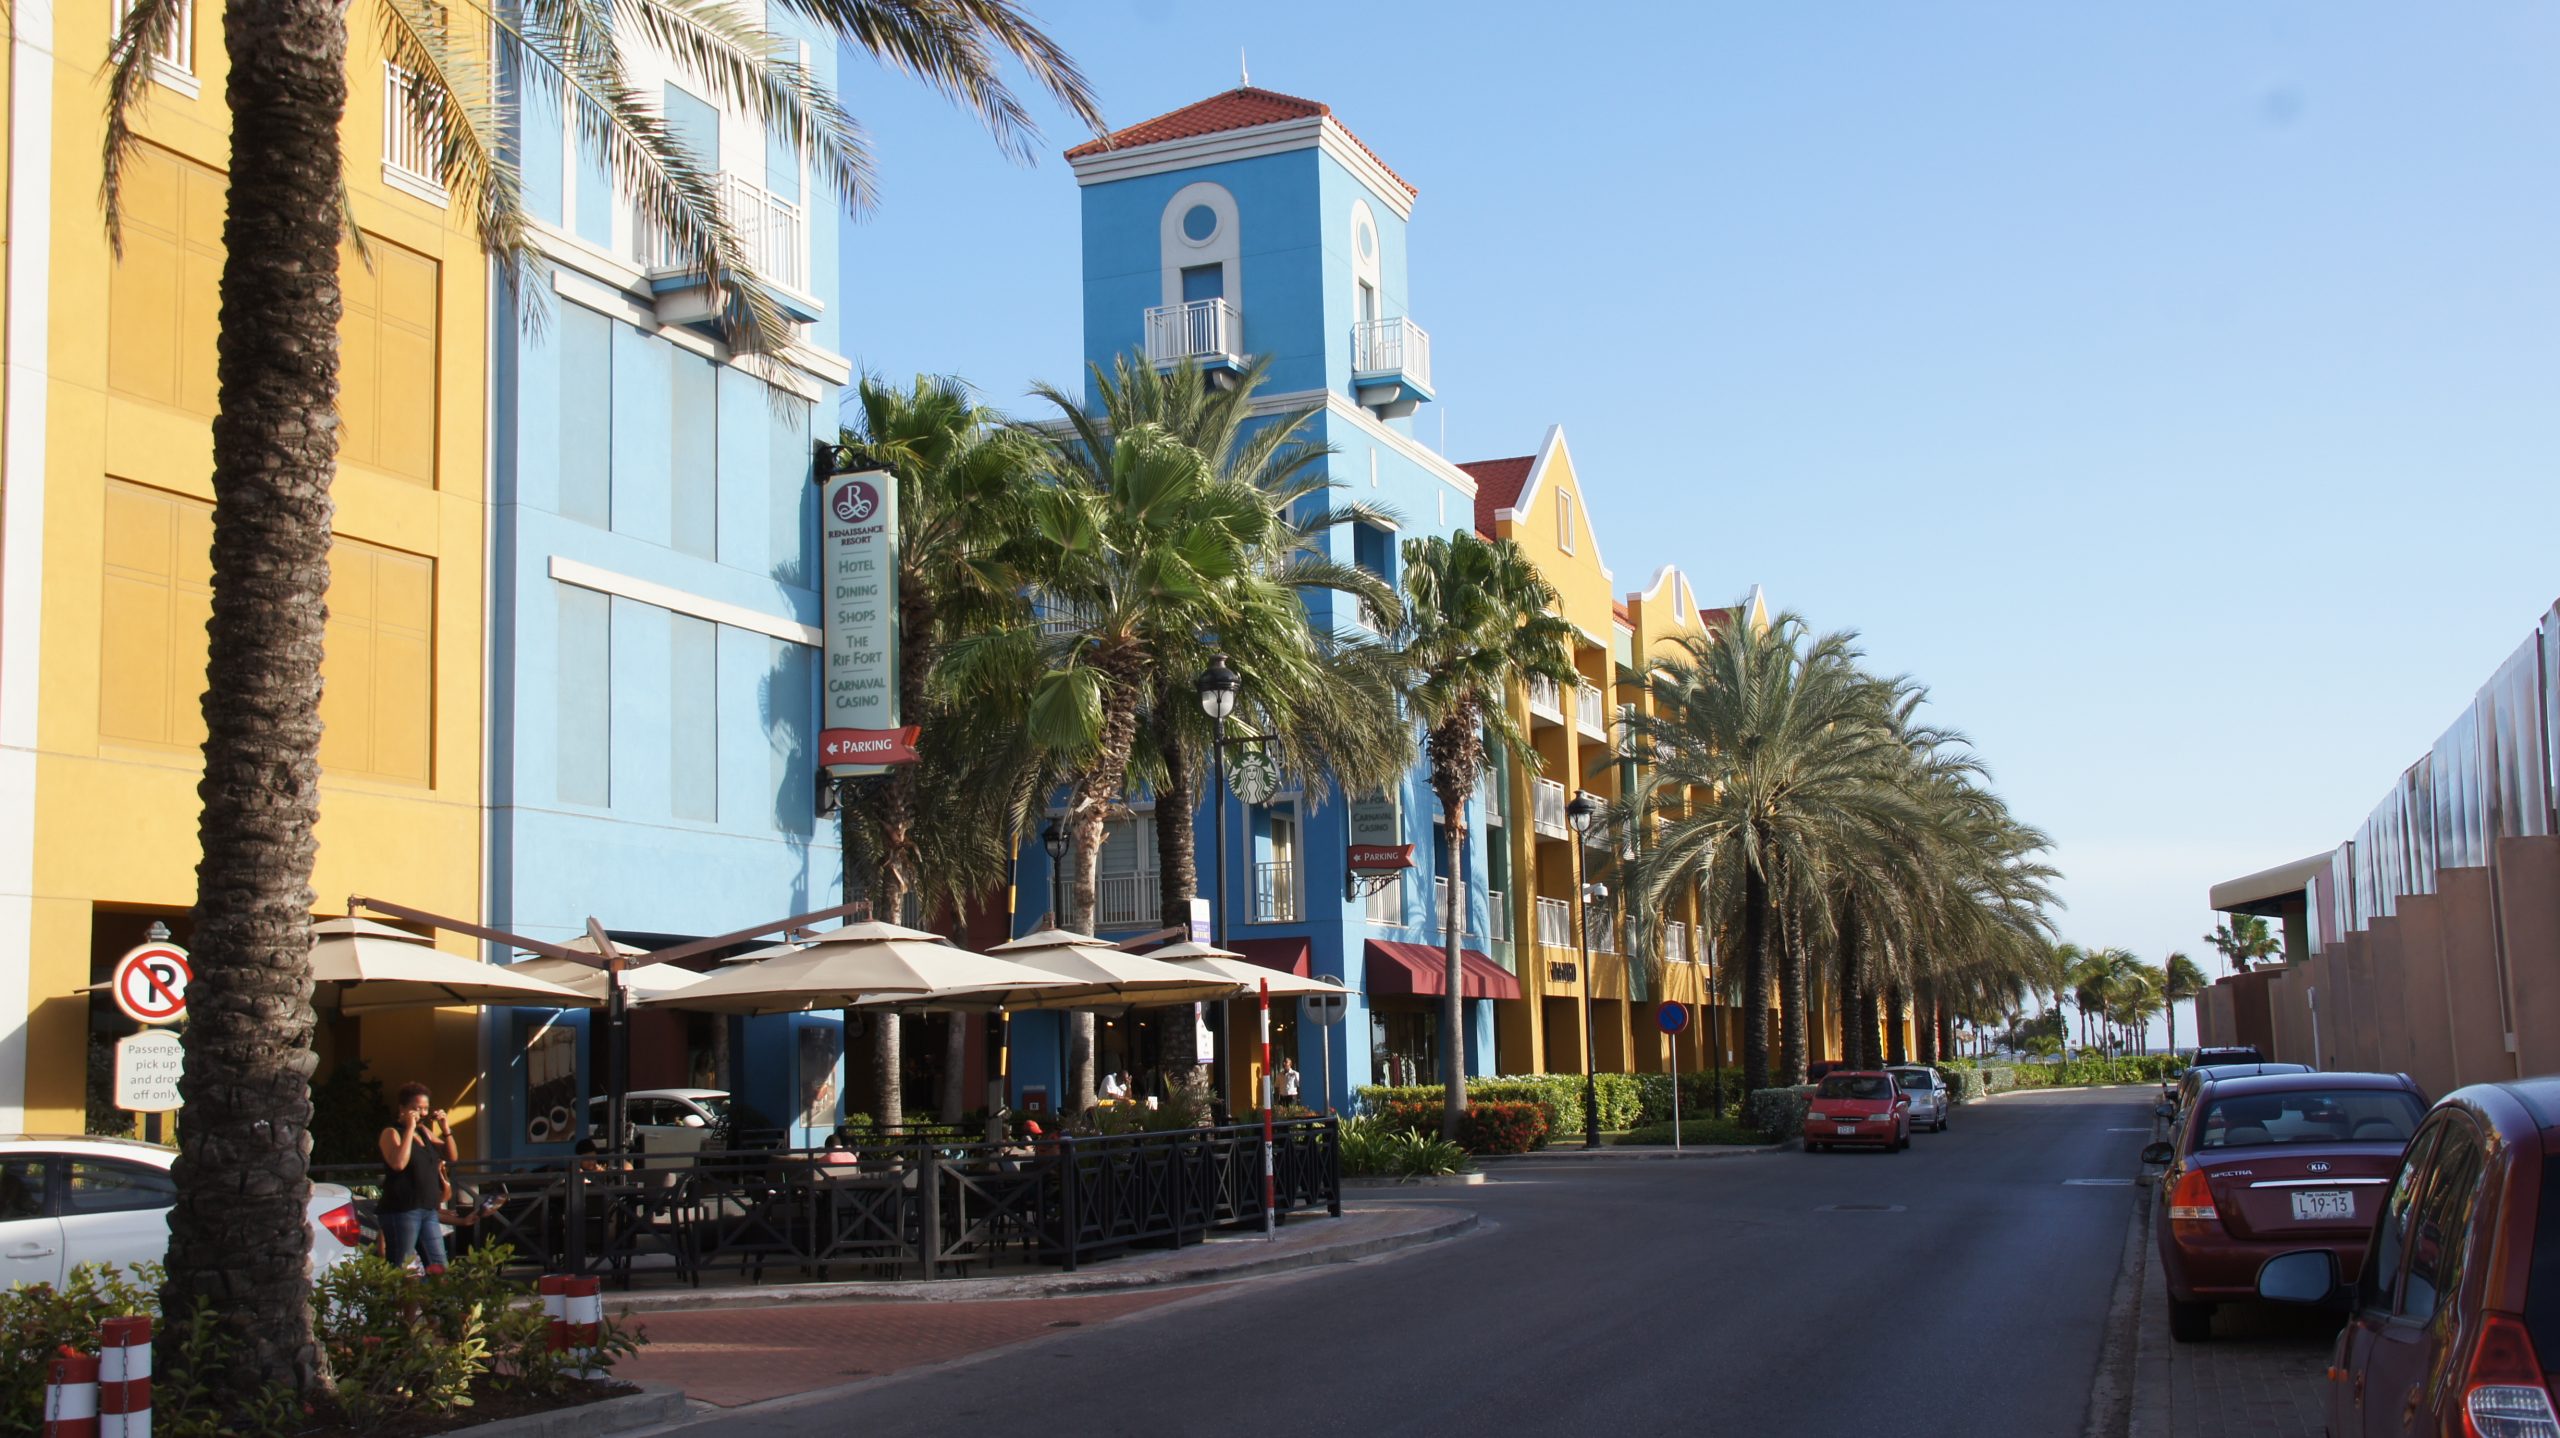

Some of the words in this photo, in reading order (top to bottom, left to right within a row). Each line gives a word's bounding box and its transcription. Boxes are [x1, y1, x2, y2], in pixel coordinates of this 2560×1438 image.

[828, 525, 884, 539] RENAISSANCE
[841, 536, 872, 547] RESORT
[838, 559, 875, 574] HOTEL
[836, 584, 878, 599] DINING
[838, 609, 876, 624] SHOPS
[845, 635, 868, 648] THE
[833, 653, 851, 667] RIF
[853, 651, 882, 665] FORT
[829, 677, 886, 693] CARNAVAL
[836, 695, 879, 709] CASINO
[842, 739, 892, 754] PARKING
[1358, 823, 1389, 833] CASINO
[1364, 852, 1399, 861] PARKING
[136, 1059, 159, 1072] pick
[162, 1060, 177, 1071] up
[130, 1074, 152, 1085] and
[133, 1090, 150, 1100] off
[153, 1089, 177, 1102] only
[2311, 1163, 2328, 1171] KIA
[2299, 1198, 2308, 1213] L
[2310, 1197, 2348, 1213] 19-13
